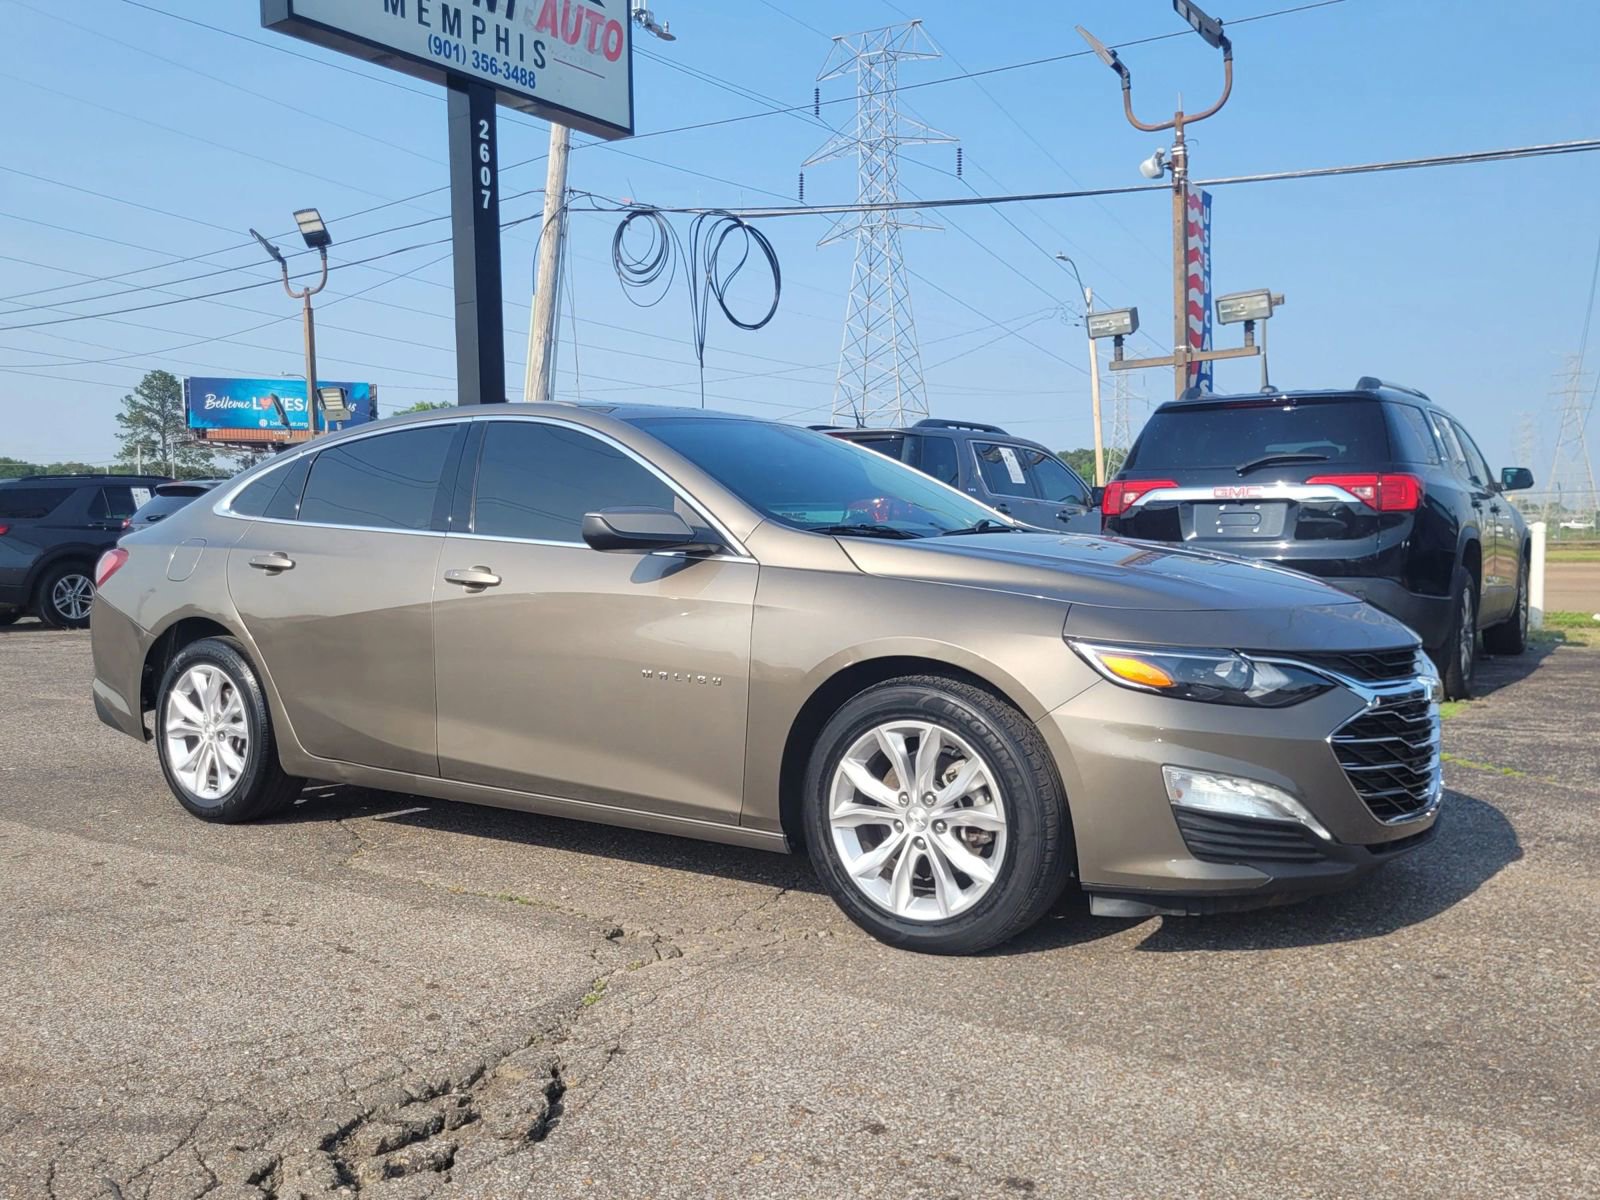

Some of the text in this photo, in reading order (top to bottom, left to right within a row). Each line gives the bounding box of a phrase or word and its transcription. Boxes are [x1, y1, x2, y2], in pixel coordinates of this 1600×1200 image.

[384, 0, 546, 70] MEMPHIS
[428, 33, 467, 66] (901)
[472, 50, 537, 90] 356-3488
[534, 0, 625, 63] AUTO
[479, 119, 491, 210] 2607
[1200, 207, 1212, 394] USED CARS
[204, 393, 251, 410] Bellevue
[1213, 486, 1264, 499] GMC
[641, 669, 722, 687] MALIBU
